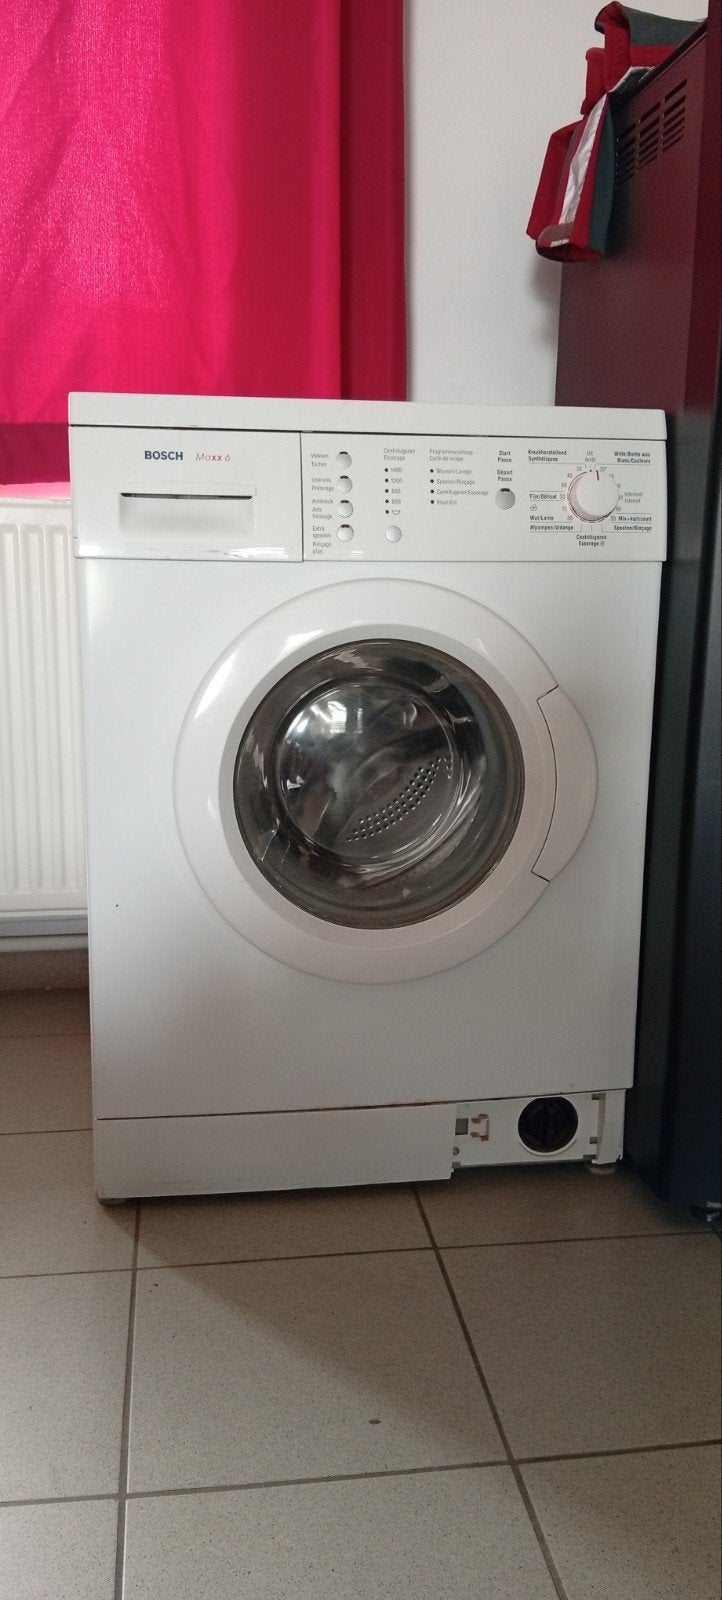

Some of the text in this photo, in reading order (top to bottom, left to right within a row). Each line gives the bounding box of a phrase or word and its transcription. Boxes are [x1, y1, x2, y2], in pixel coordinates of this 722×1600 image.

[144, 450, 184, 461] BOSCH
[195, 452, 231, 462] Maxx 6
